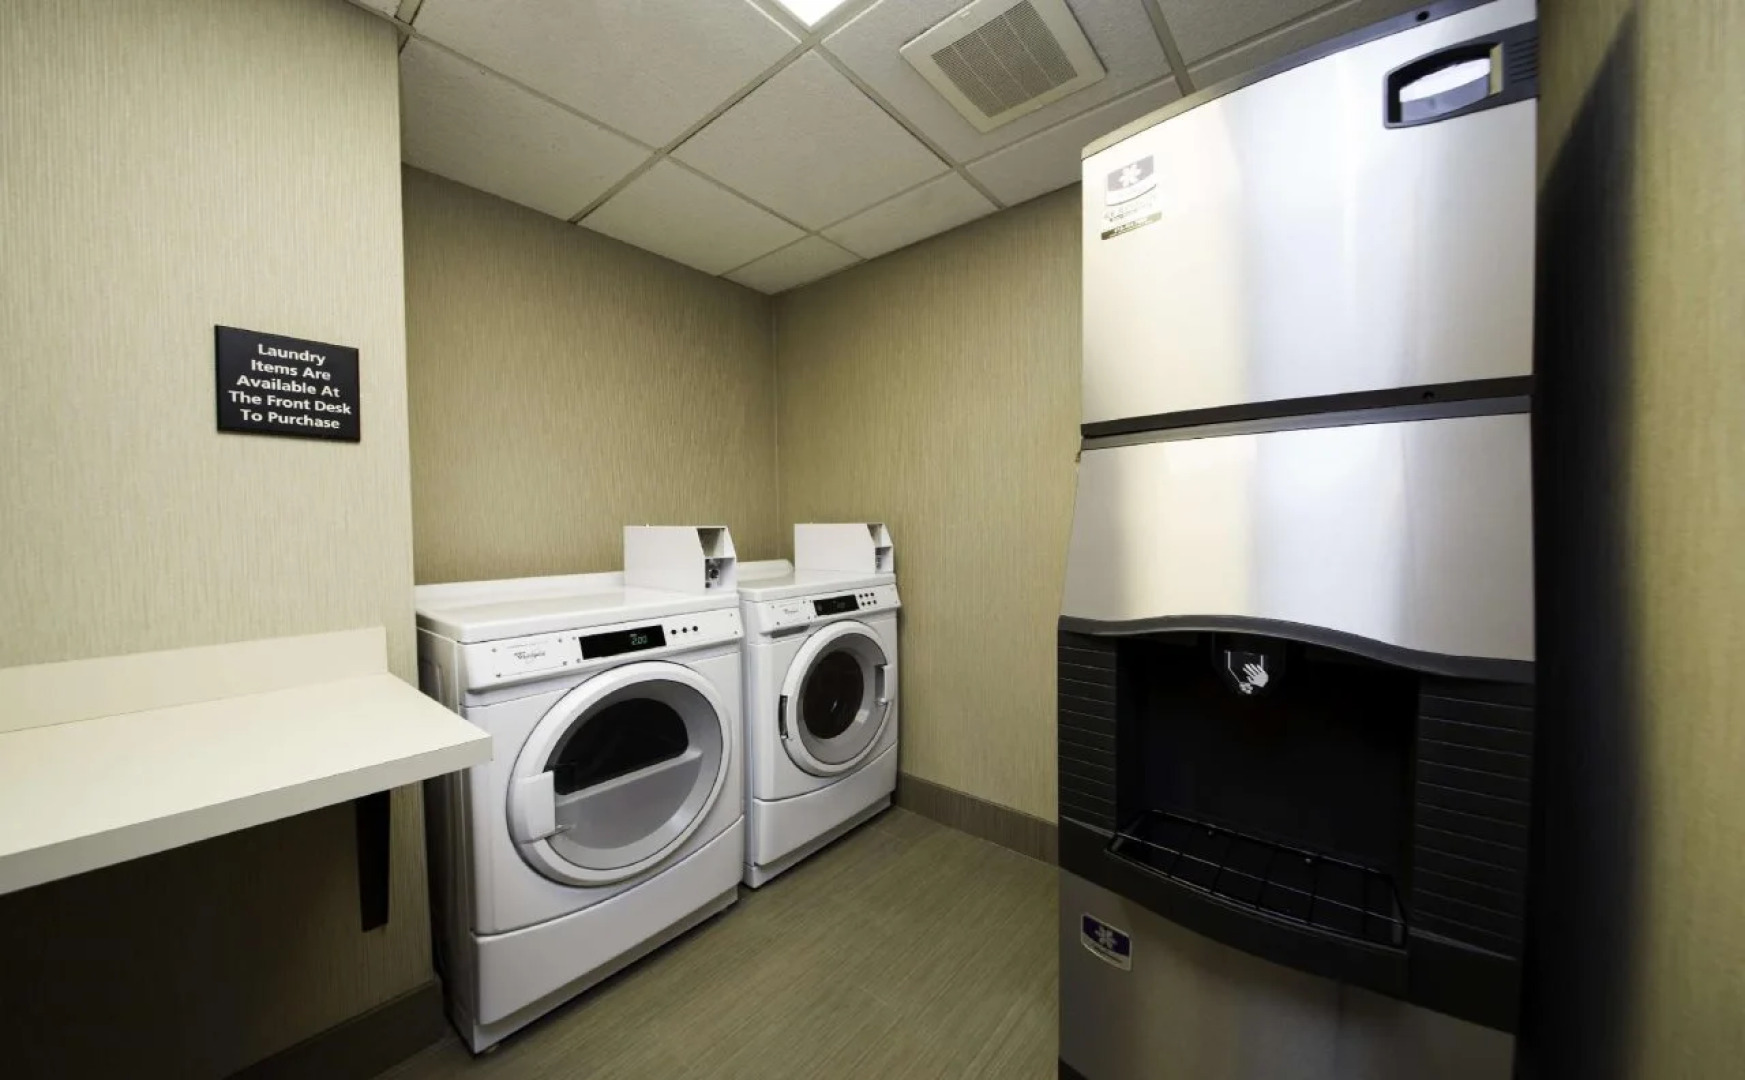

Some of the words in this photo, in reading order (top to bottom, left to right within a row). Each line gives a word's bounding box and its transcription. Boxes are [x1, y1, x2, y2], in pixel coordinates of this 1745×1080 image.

[257, 343, 326, 366] Laundry
[251, 359, 298, 376] Items
[302, 367, 331, 381] Are
[236, 375, 317, 395] Available
[321, 386, 341, 398] At
[228, 390, 262, 405] The
[267, 395, 311, 410] Front
[314, 401, 352, 415] Desk
[240, 409, 263, 422] To
[268, 412, 340, 429] Purchase
